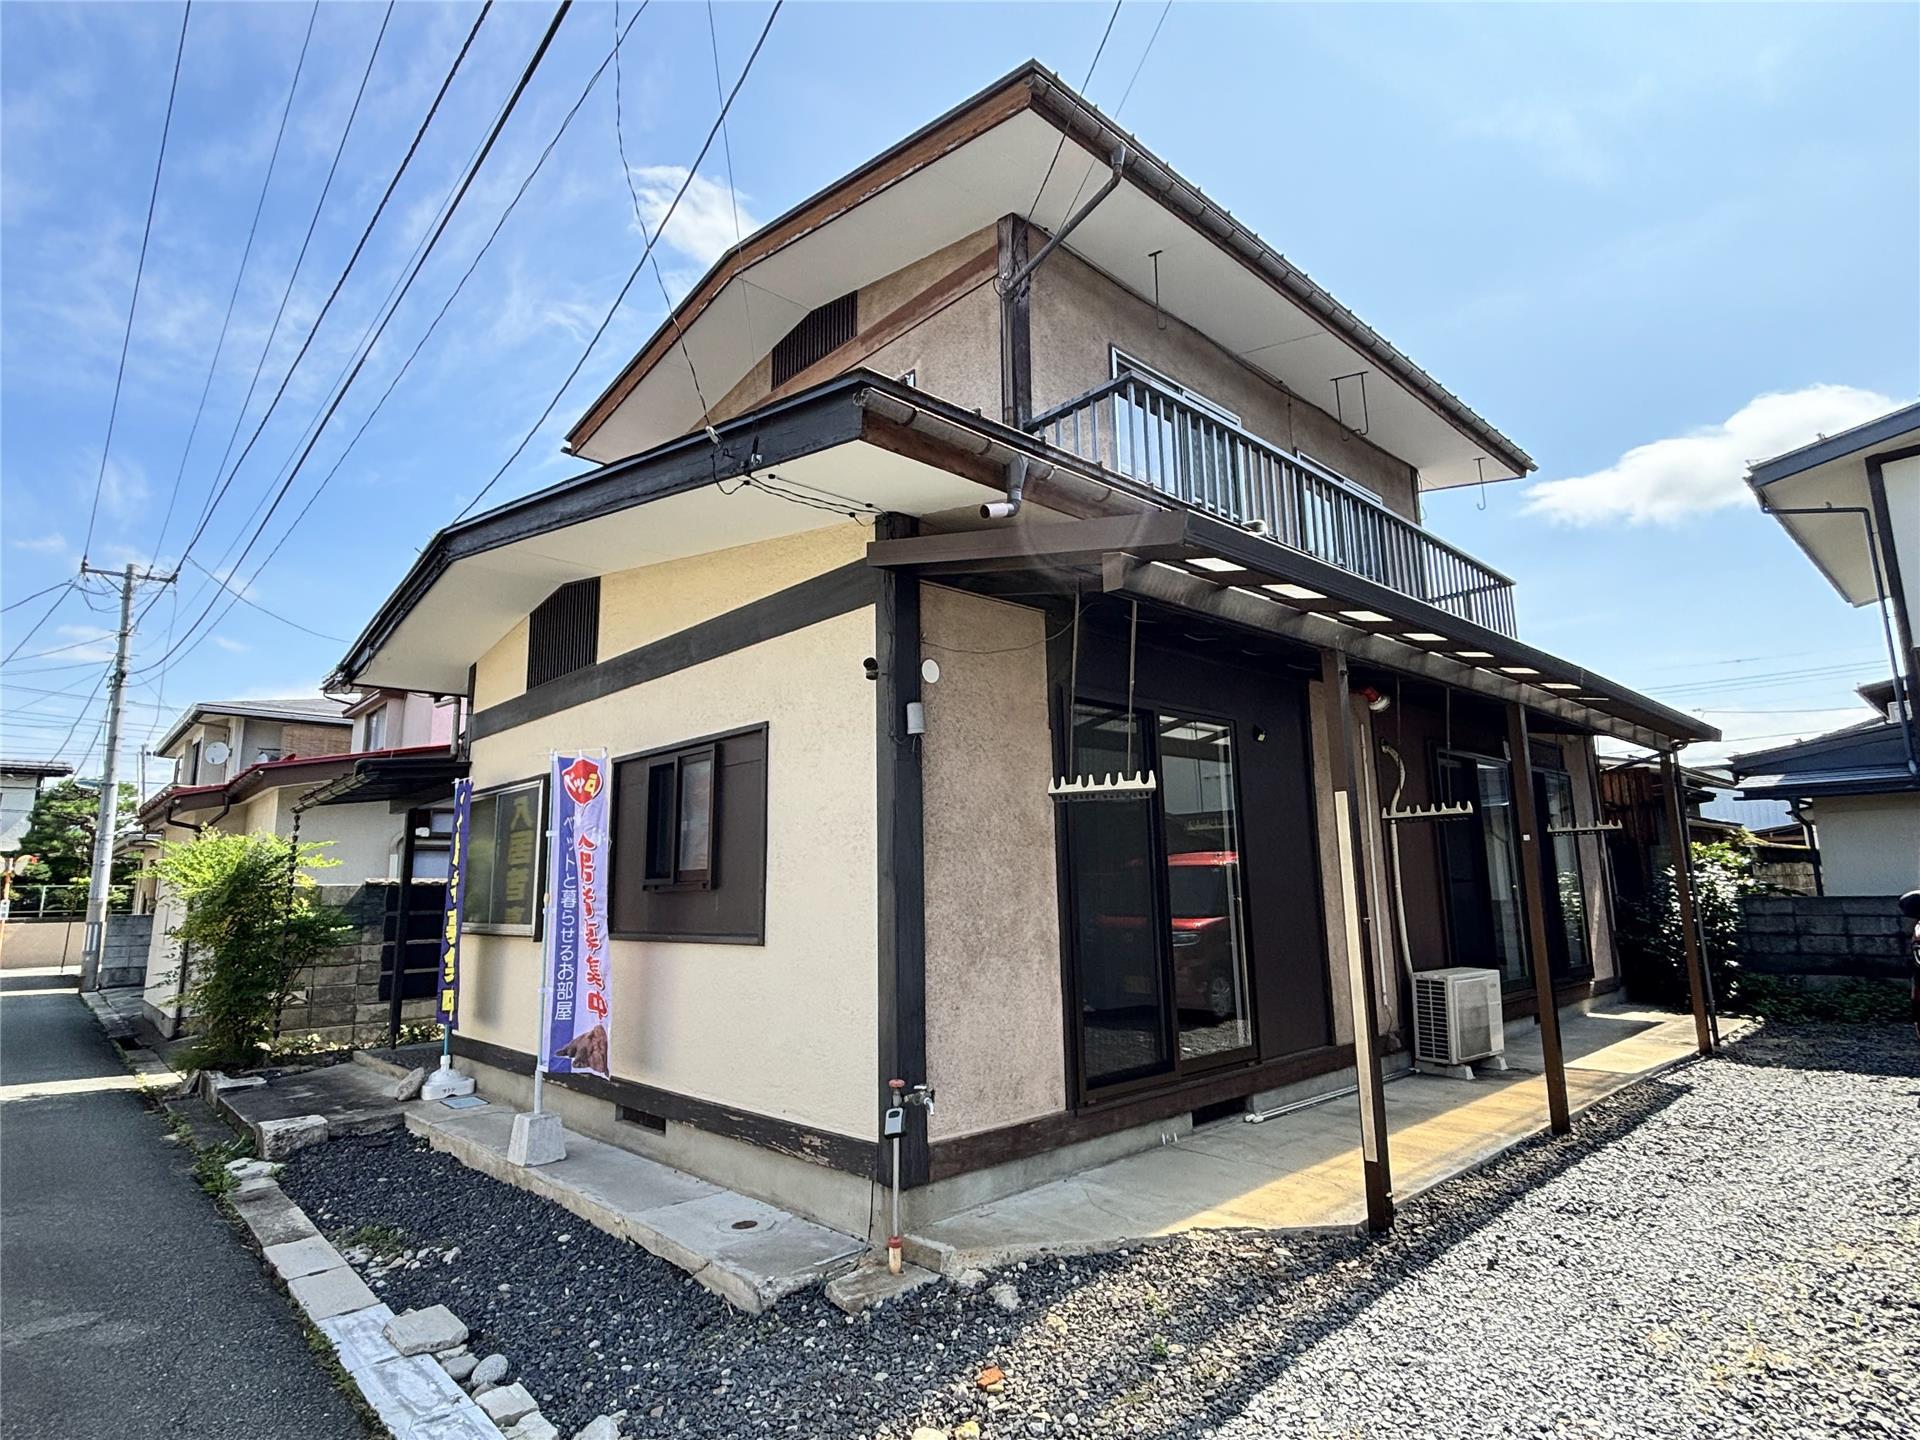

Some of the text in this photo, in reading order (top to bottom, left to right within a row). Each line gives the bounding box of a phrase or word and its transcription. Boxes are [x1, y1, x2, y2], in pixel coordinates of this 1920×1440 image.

[554, 816, 577, 1021] ペットと暮らせるお部屋
